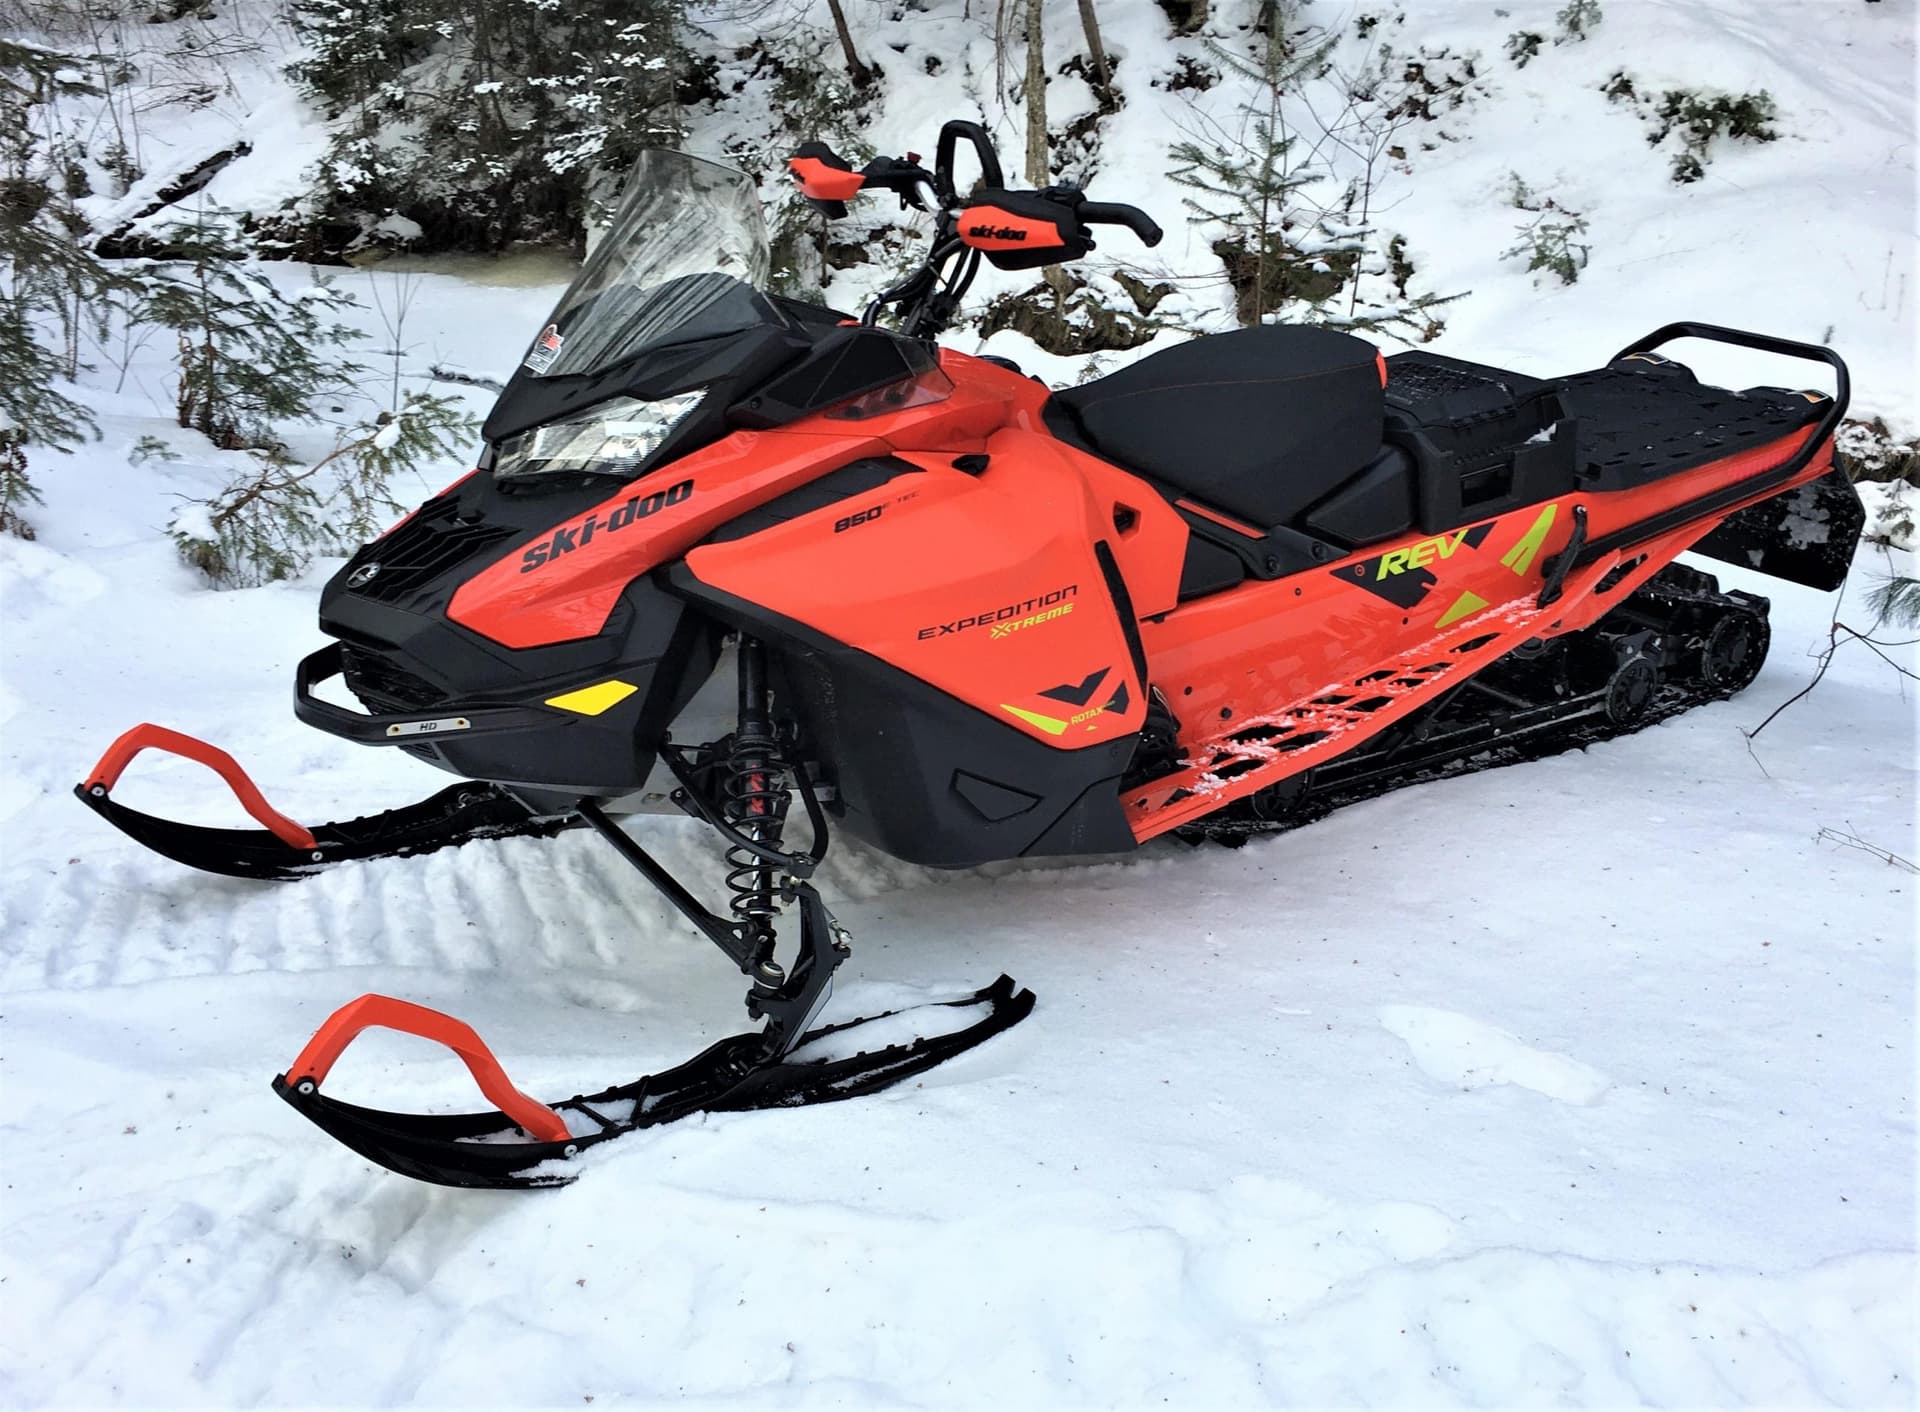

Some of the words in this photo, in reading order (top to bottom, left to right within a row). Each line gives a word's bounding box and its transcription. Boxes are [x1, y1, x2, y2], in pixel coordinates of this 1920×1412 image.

[834, 505, 882, 533] 850
[1377, 529, 1469, 581] REV
[918, 585, 1077, 640] EXPEDITION
[990, 603, 1074, 639] XTREME
[420, 723, 437, 731] HD
[1071, 700, 1116, 725] ROTAX
